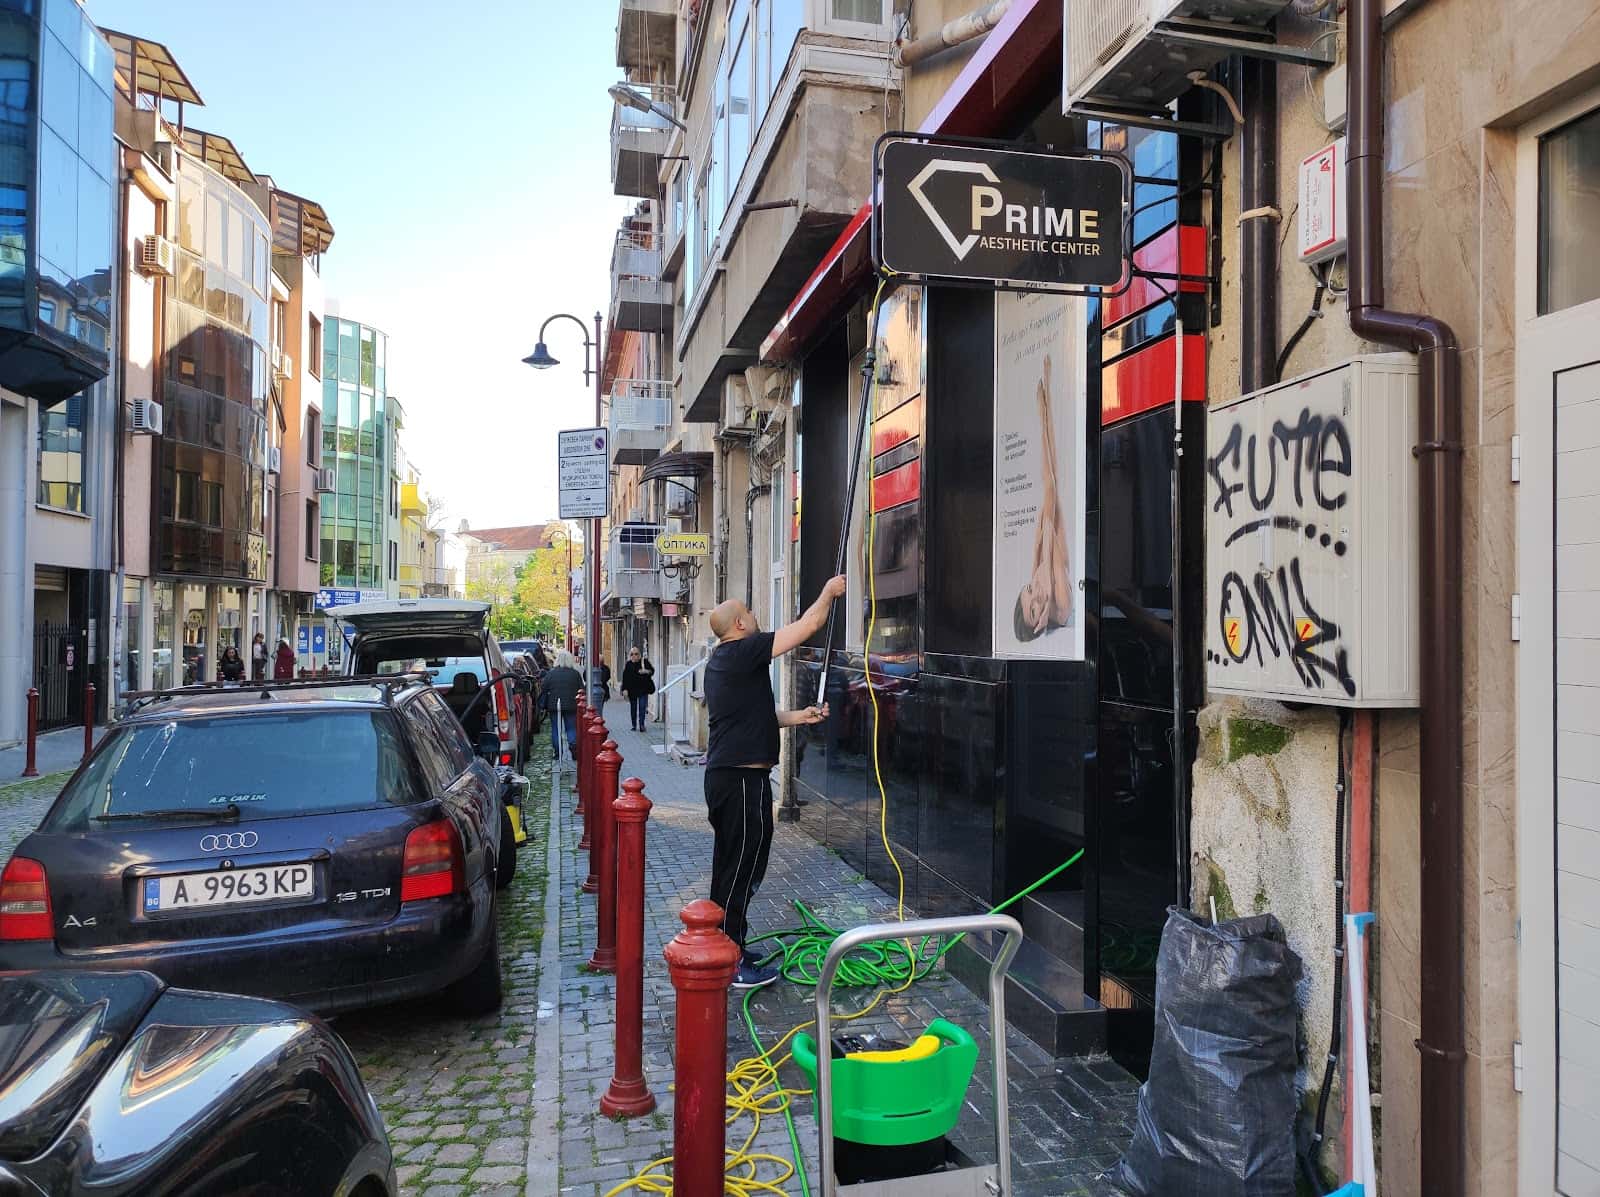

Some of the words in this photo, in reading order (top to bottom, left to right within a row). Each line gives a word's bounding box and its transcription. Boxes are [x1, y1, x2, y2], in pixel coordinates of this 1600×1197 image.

[971, 185, 1099, 239] PRIME
[980, 236, 1049, 253] AESTHETIC
[1051, 241, 1100, 256] CENTER
[663, 540, 706, 550] ОПТИКА
[361, 887, 391, 899] TDI
[147, 897, 159, 906] BG
[63, 914, 97, 928] A4
